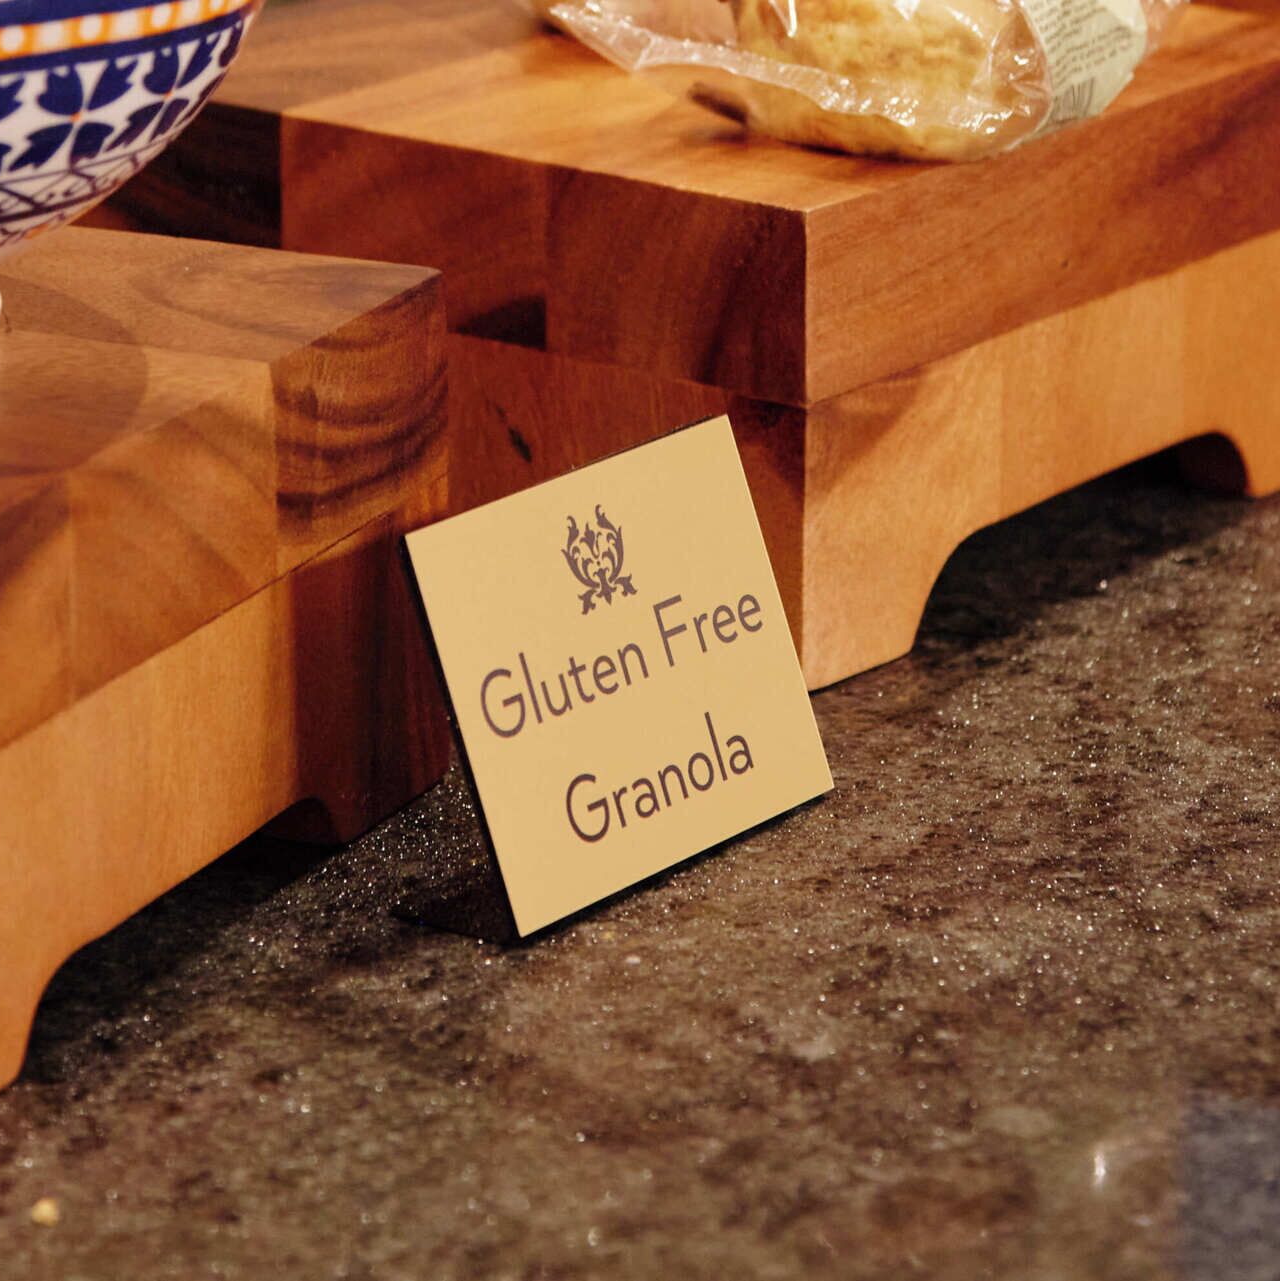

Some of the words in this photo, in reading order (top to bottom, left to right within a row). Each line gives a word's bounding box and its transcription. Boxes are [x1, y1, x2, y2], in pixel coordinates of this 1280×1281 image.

[480, 641, 650, 738] Gluten
[653, 593, 765, 667] Free
[565, 711, 755, 843] Granola
